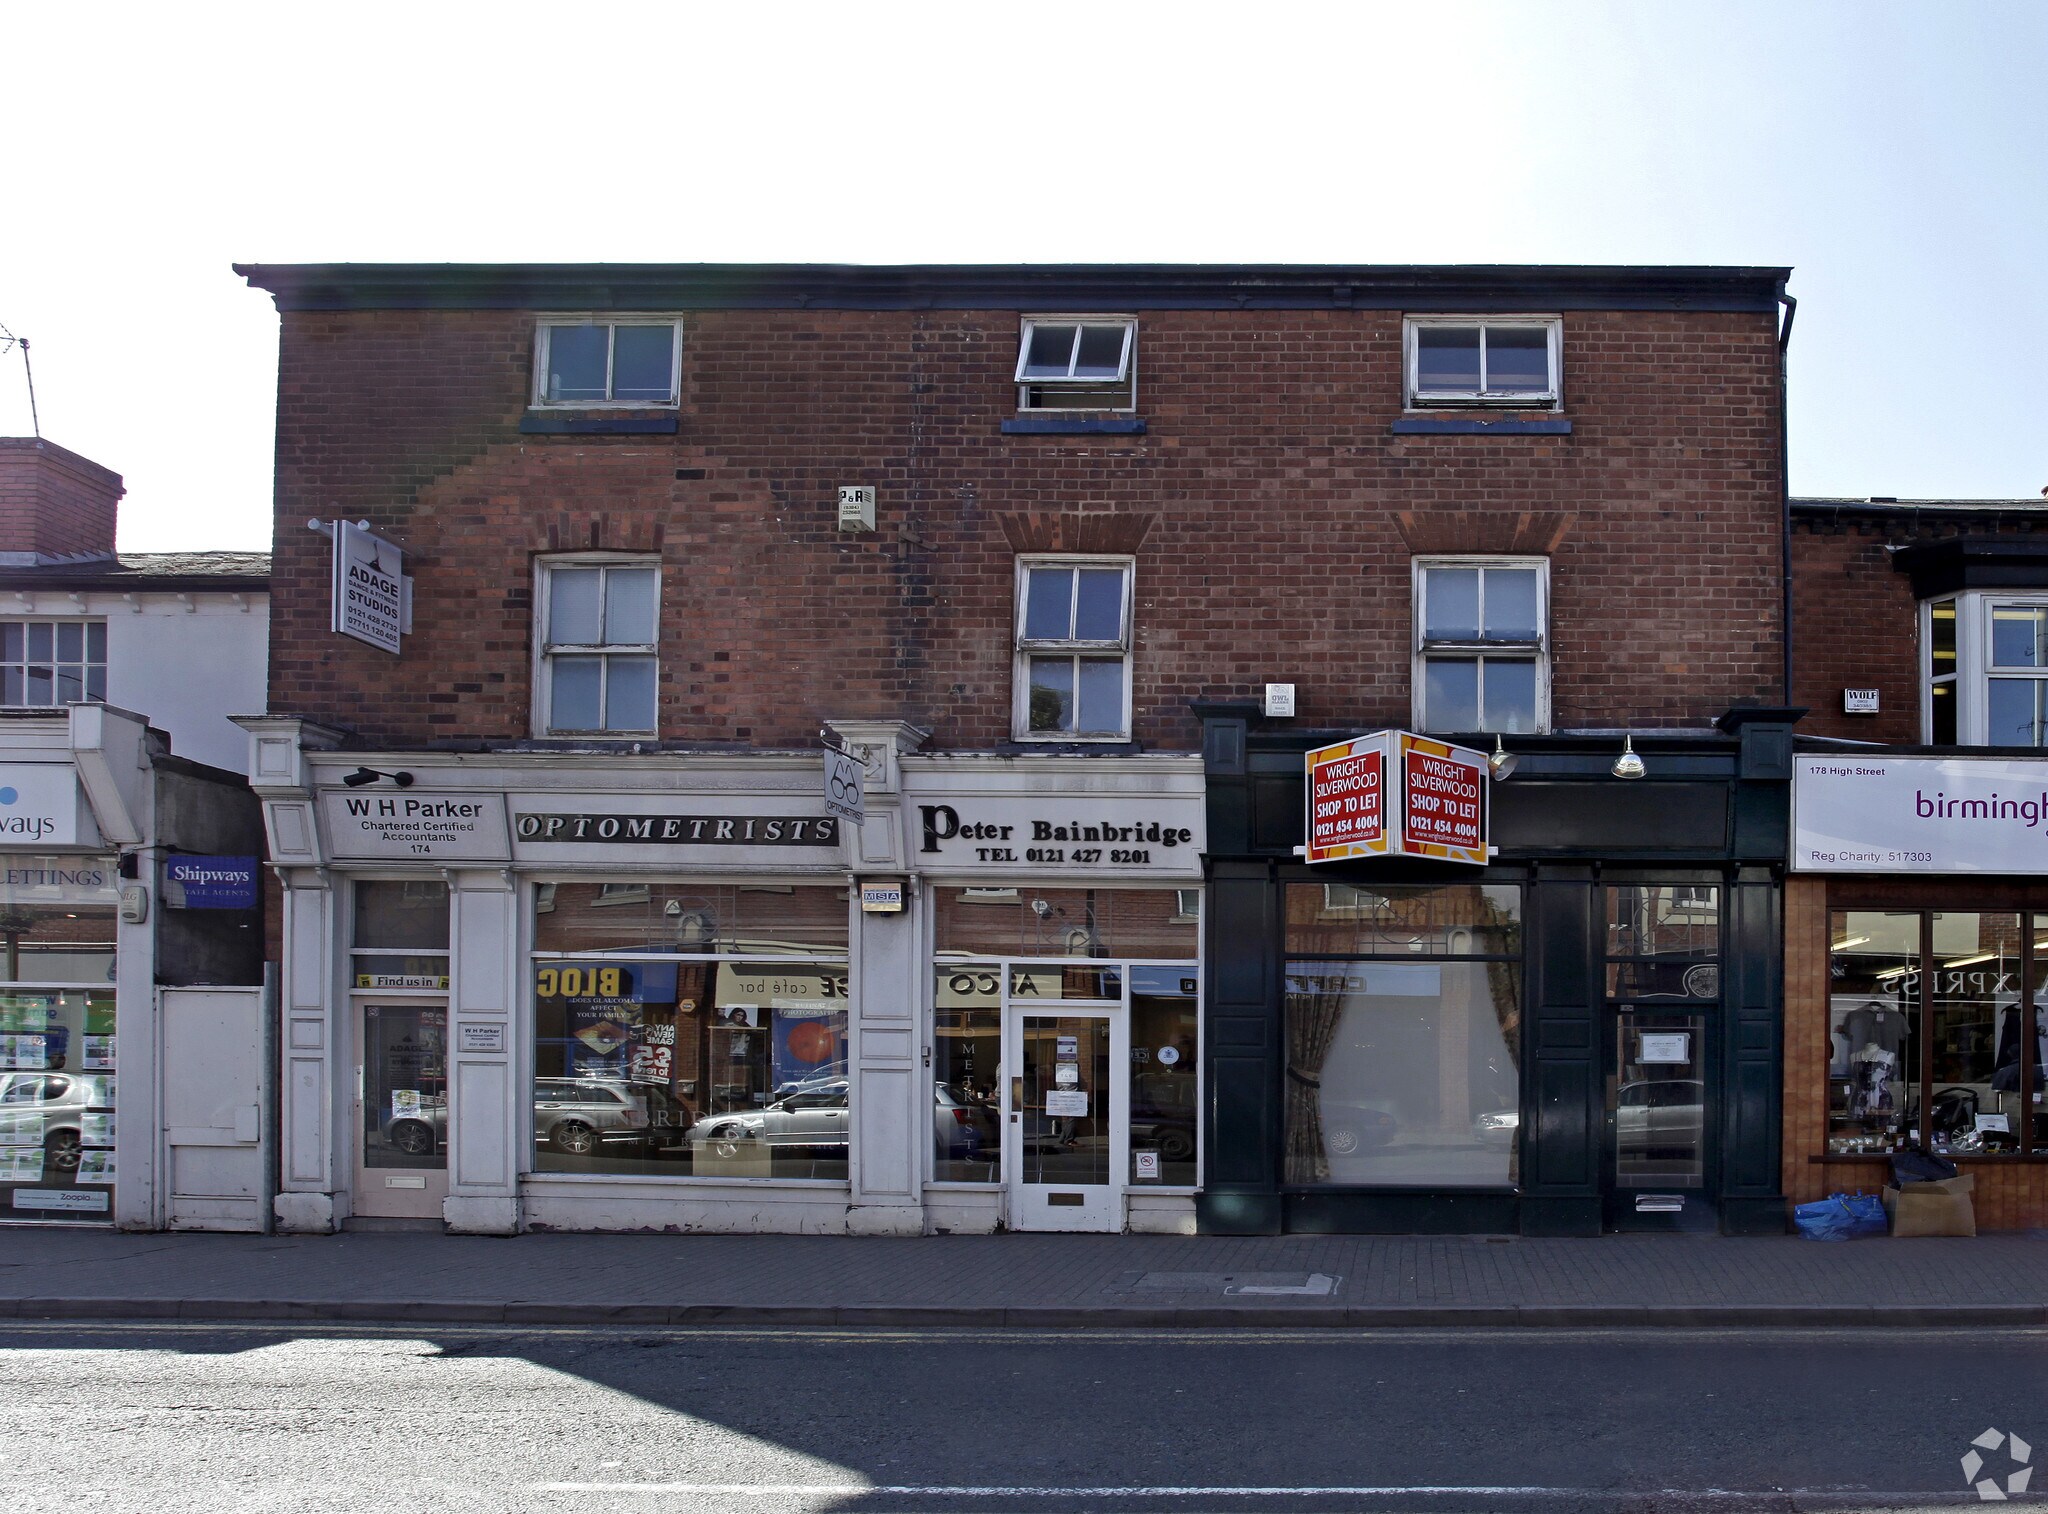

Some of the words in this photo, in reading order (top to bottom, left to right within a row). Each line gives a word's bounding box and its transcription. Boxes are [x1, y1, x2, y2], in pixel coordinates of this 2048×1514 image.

[349, 566, 399, 598] ADAGE
[349, 580, 369, 593] DANCE
[375, 592, 398, 607] FITNESS
[349, 590, 398, 619] STUDIOS
[348, 606, 366, 618] 0121
[367, 614, 380, 625] 428
[382, 620, 398, 633] 2732
[348, 617, 370, 631] 07711
[372, 627, 384, 636] 120
[385, 633, 398, 643] 405
[1848, 691, 1877, 700] WOLF
[1326, 758, 1366, 780] WRIGHT
[1422, 759, 1466, 781] WRIGHT
[1809, 767, 1827, 775] 178
[1829, 767, 1853, 777] High
[1855, 767, 1886, 776] Street
[1317, 772, 1377, 798] SILVERWOOD
[1411, 772, 1476, 798] SILVERWOOD
[346, 799, 370, 816] W
[378, 799, 396, 817] H
[405, 799, 483, 817] Parker
[827, 800, 864, 821] OPTOMETRIST
[1317, 800, 1341, 818] SHOP
[1344, 797, 1357, 813] TO
[1360, 793, 1377, 811] LET
[1411, 794, 1440, 812] SHOP
[1443, 799, 1457, 815] TO
[1460, 803, 1476, 818] LET
[361, 821, 420, 831] Chartered
[423, 822, 474, 831] Certified
[382, 832, 457, 842] Accountants
[517, 816, 837, 841] OPTOMETRISTS
[918, 804, 1014, 853] Peter
[1031, 820, 1192, 847] Bainbridge
[1316, 822, 1334, 837] 0121
[1336, 819, 1352, 833] 454
[1355, 815, 1378, 830] 4004
[1410, 815, 1431, 831] 0121
[1434, 820, 1451, 833] 454
[1454, 823, 1477, 838] 4004
[410, 844, 431, 853] 174
[975, 848, 1018, 862] TEL
[1025, 849, 1065, 863] 0121
[1071, 849, 1102, 863] 427
[1110, 849, 1151, 864] 8201
[1811, 851, 1835, 864] Reg
[1839, 851, 1884, 864] Charity:
[1888, 852, 1932, 862] 517303
[0, 869, 103, 886] ETTINGS
[174, 865, 250, 886] Shipways
[377, 976, 404, 986] Find
[422, 977, 433, 986] in
[60, 1193, 91, 1202] Zoopla
